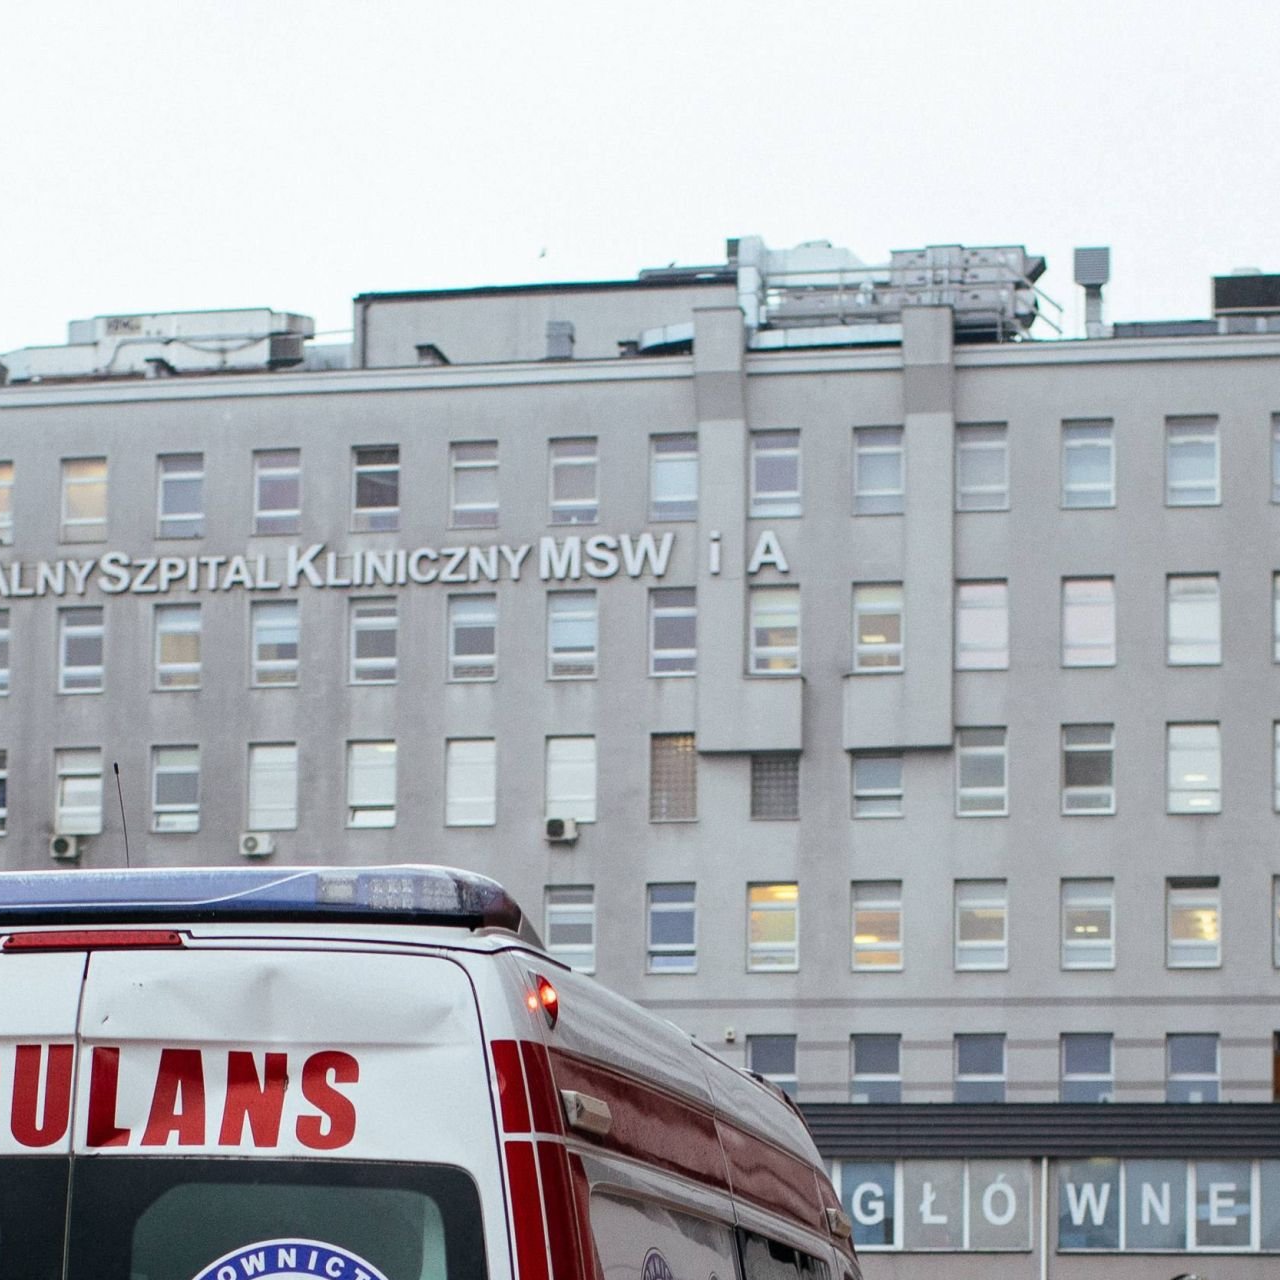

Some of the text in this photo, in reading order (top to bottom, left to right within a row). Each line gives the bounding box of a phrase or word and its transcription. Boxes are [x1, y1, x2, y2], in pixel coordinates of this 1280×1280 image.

[97, 551, 281, 595] SZPITAL
[287, 542, 532, 588] KLINICZNY
[538, 532, 675, 580] MSW
[709, 530, 721, 575] i
[747, 530, 790, 574] A
[852, 1174, 1237, 1227] GŁÓWNE
